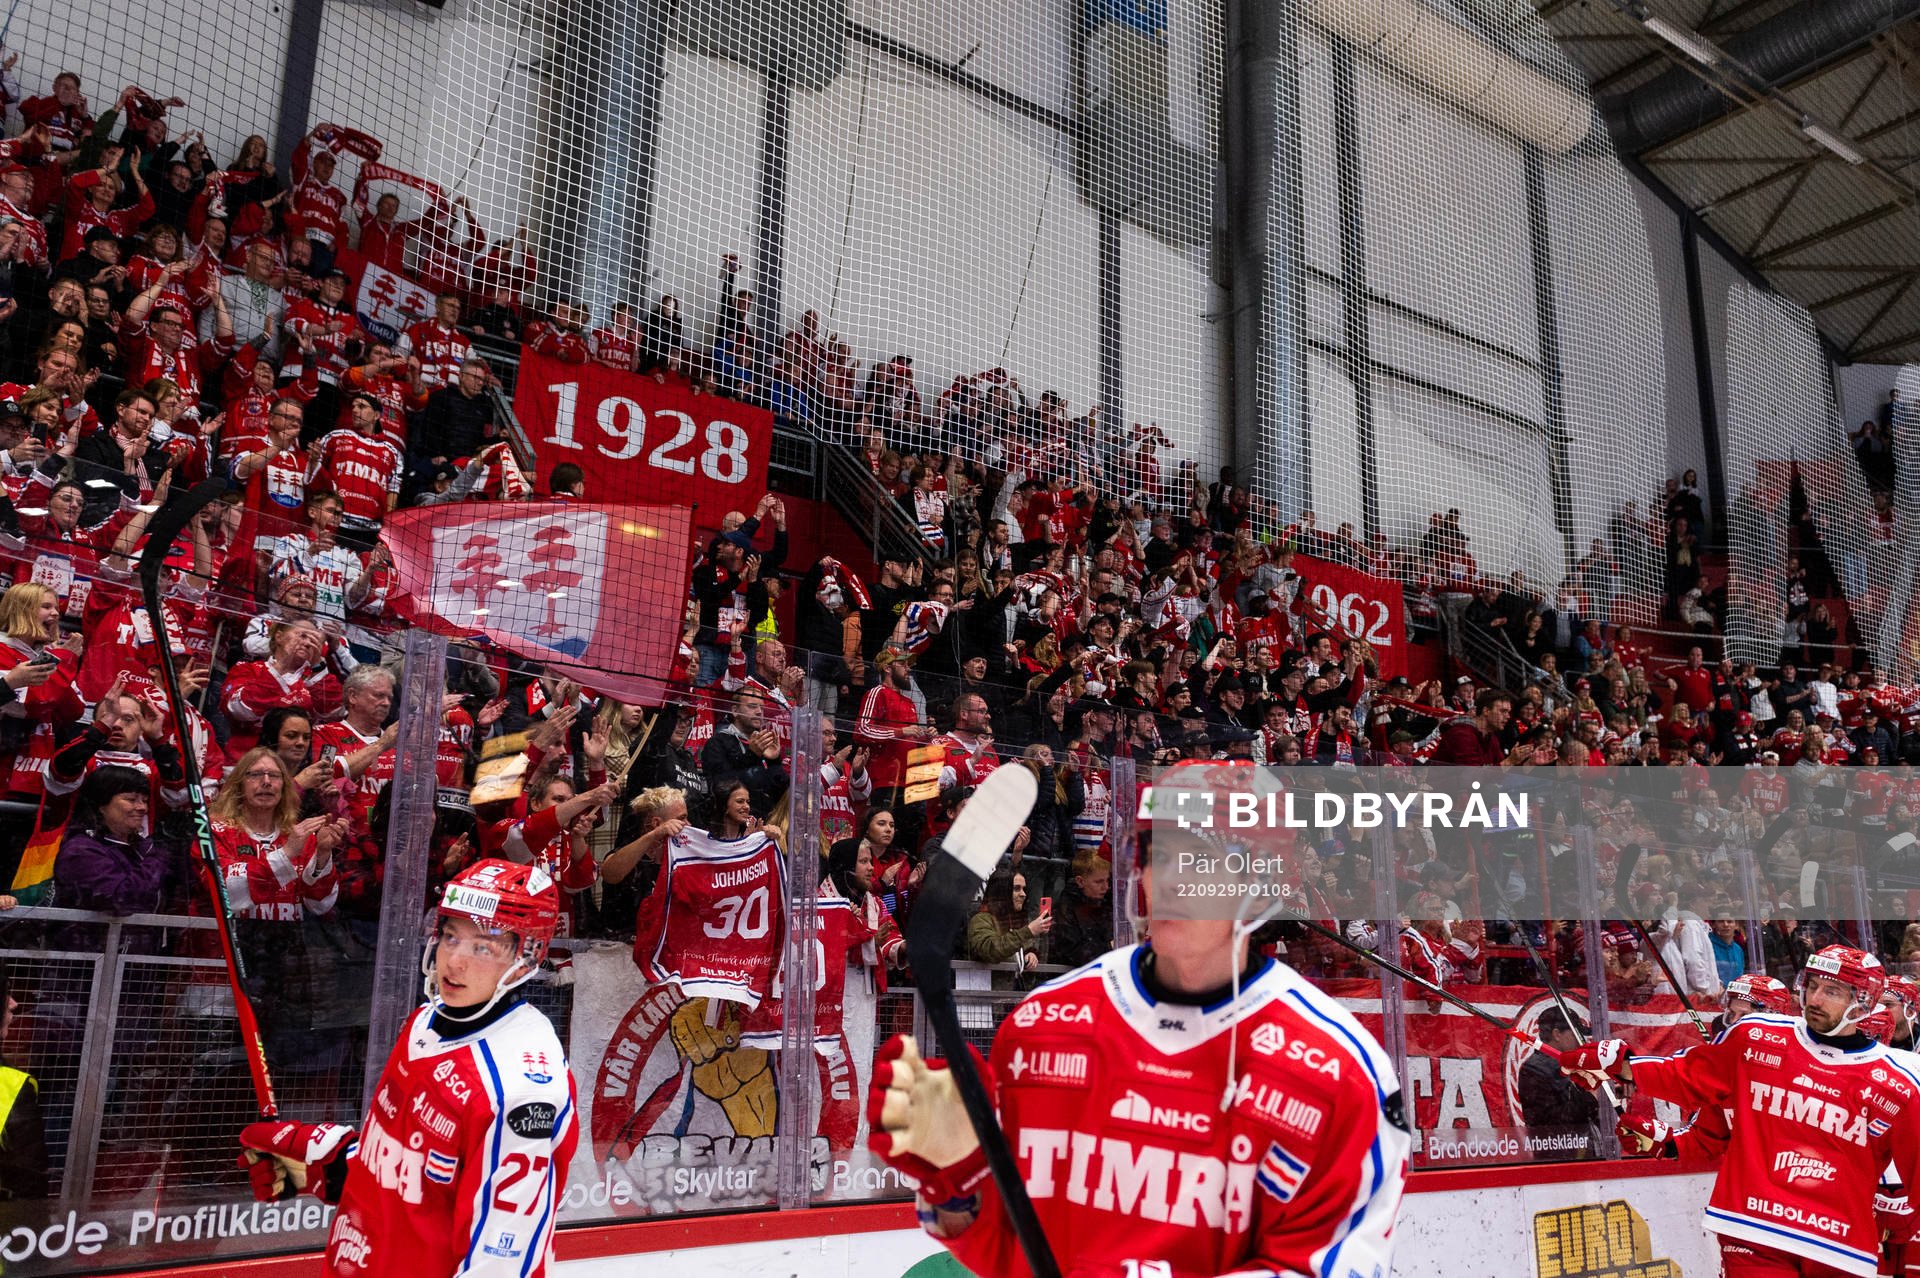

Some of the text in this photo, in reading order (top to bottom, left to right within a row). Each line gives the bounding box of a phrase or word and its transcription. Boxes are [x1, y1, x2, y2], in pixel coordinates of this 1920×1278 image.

[543, 382, 749, 484] 1928
[1310, 584, 1393, 647] 962
[189, 783, 215, 861] SYNC
[711, 858, 769, 889] JOHANSSON
[460, 891, 497, 912] LILIUM
[702, 885, 770, 940] 30
[1816, 958, 1840, 972] LILIUM
[1044, 1003, 1094, 1024] SCA
[1158, 1018, 1187, 1032] SHL
[1764, 1032, 1788, 1047] SCA
[603, 1038, 641, 1099] VÅR
[1030, 1051, 1088, 1079] LILIUM
[1286, 1040, 1341, 1081] SCA
[1753, 1050, 1782, 1065] LILIUM
[445, 1073, 472, 1106] SCA
[1812, 1083, 1842, 1098] NHC
[1872, 1093, 1901, 1116] LILIUM
[1888, 1077, 1912, 1099] SCA
[420, 1101, 457, 1140] LILIUM
[524, 1105, 552, 1121] Yrkes
[1151, 1107, 1212, 1133] NHC
[1253, 1084, 1323, 1136] LILIUM
[1750, 1080, 1869, 1147] TIMRÅ
[1524, 1135, 1589, 1152] Arbetskläder
[1774, 1150, 1831, 1172] Miami
[493, 1152, 551, 1217] 27
[674, 1165, 758, 1198] Skyltar
[1019, 1127, 1258, 1235] TIMRÅ
[129, 1199, 336, 1247] Profilkläder
[331, 1214, 368, 1248] Miami
[1747, 1196, 1851, 1237] BILBOLAGET
[1534, 1203, 1635, 1278] EURO
